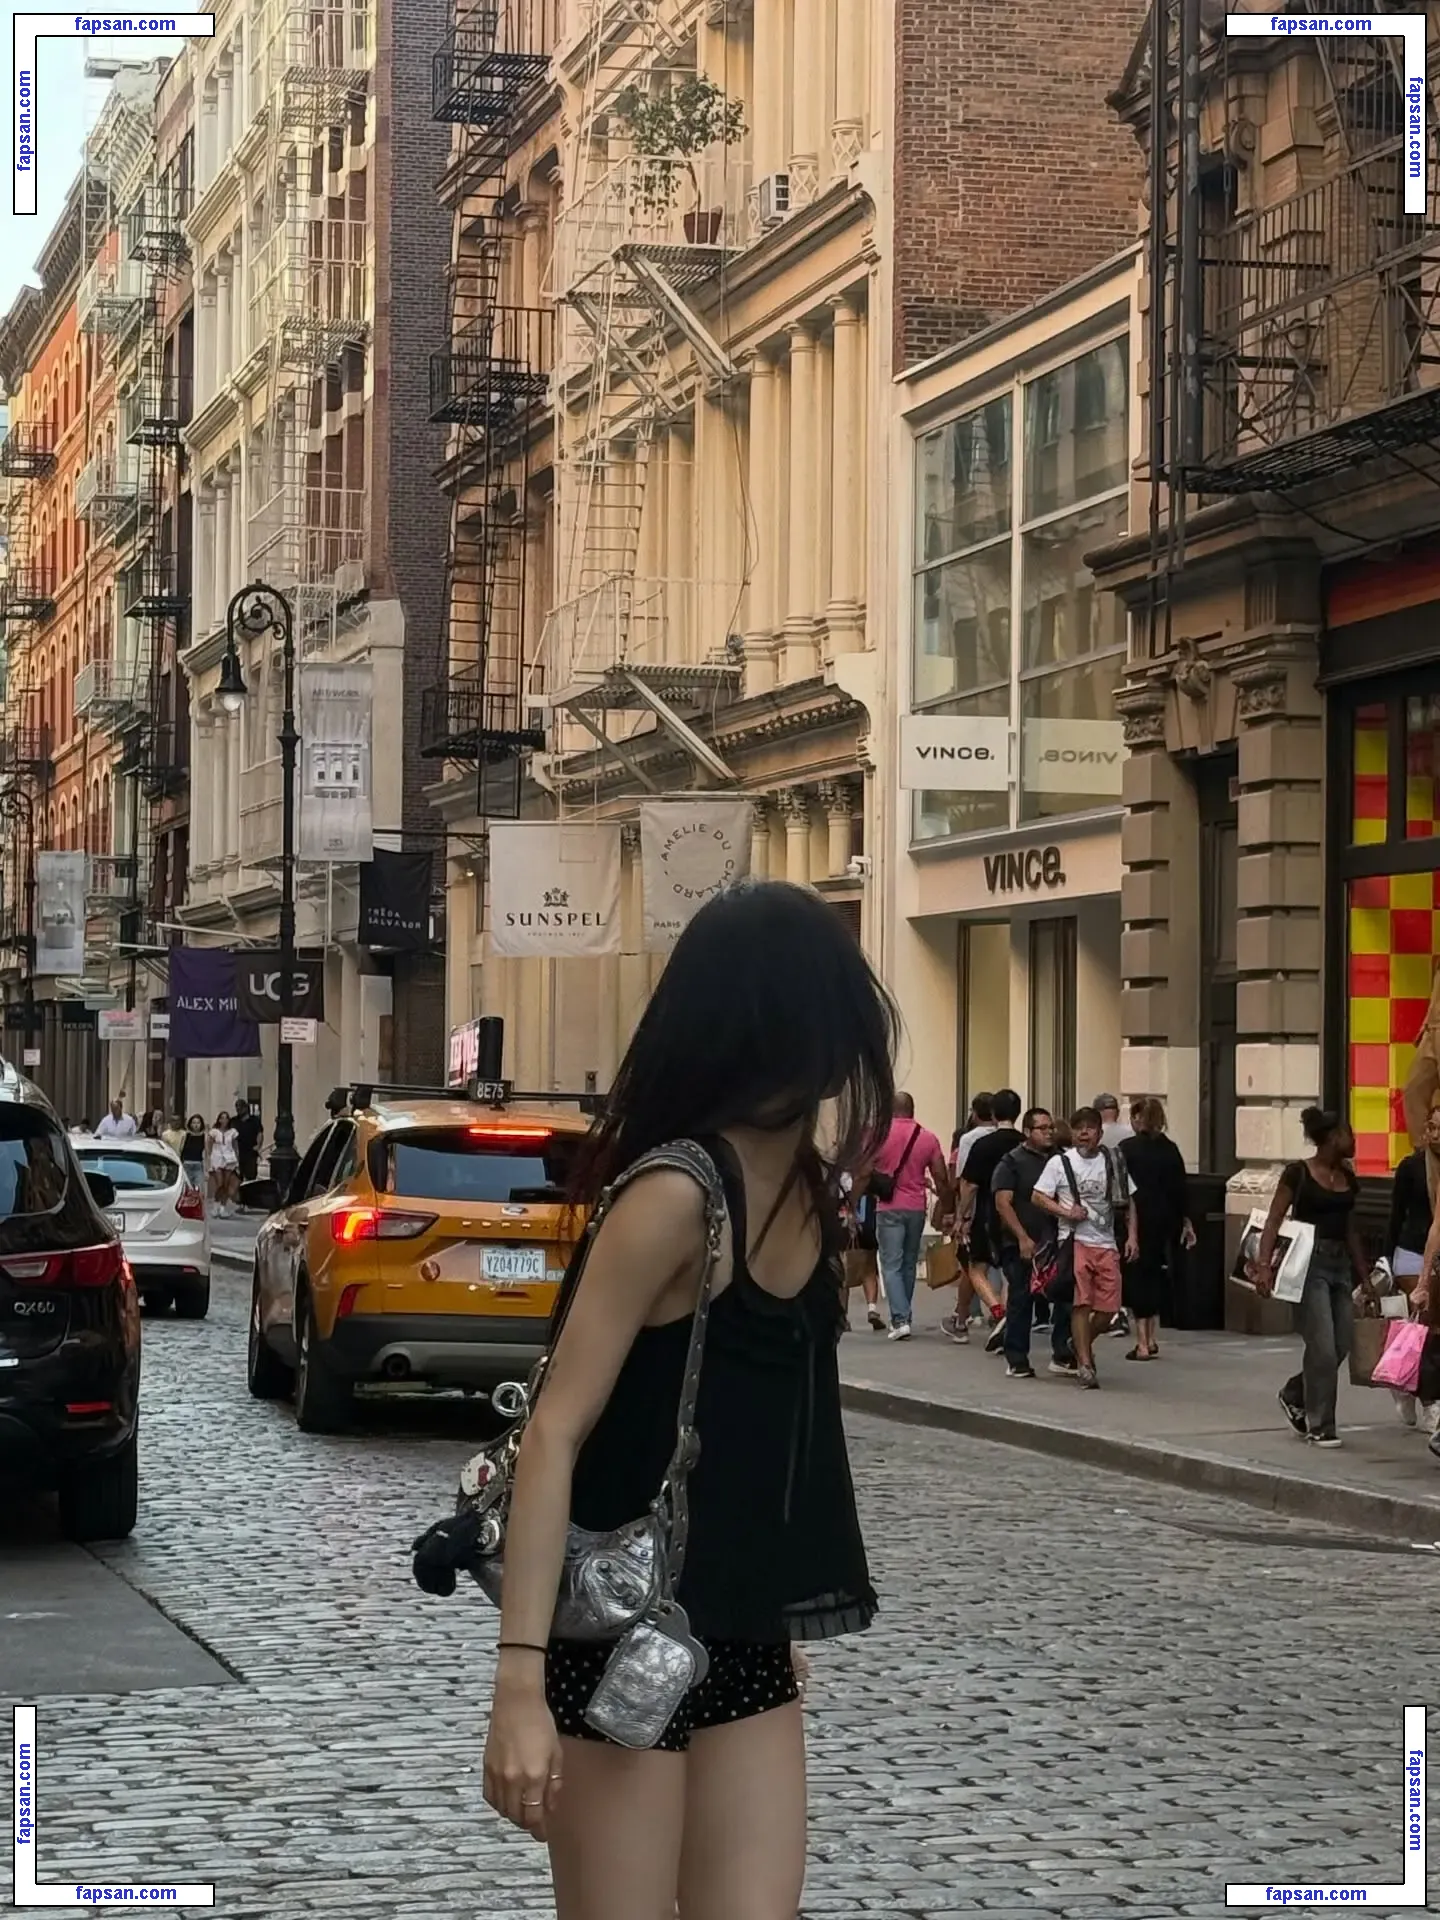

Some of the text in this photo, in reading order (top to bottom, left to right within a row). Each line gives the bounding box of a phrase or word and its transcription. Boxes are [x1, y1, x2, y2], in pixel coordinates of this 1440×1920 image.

[660, 823, 707, 861] AMELIE
[713, 830, 732, 850] DU
[504, 911, 608, 927] SUNSPEL
[176, 995, 214, 1011] ALEX
[477, 1082, 505, 1099] 8E75
[14, 1301, 56, 1316] QX60
